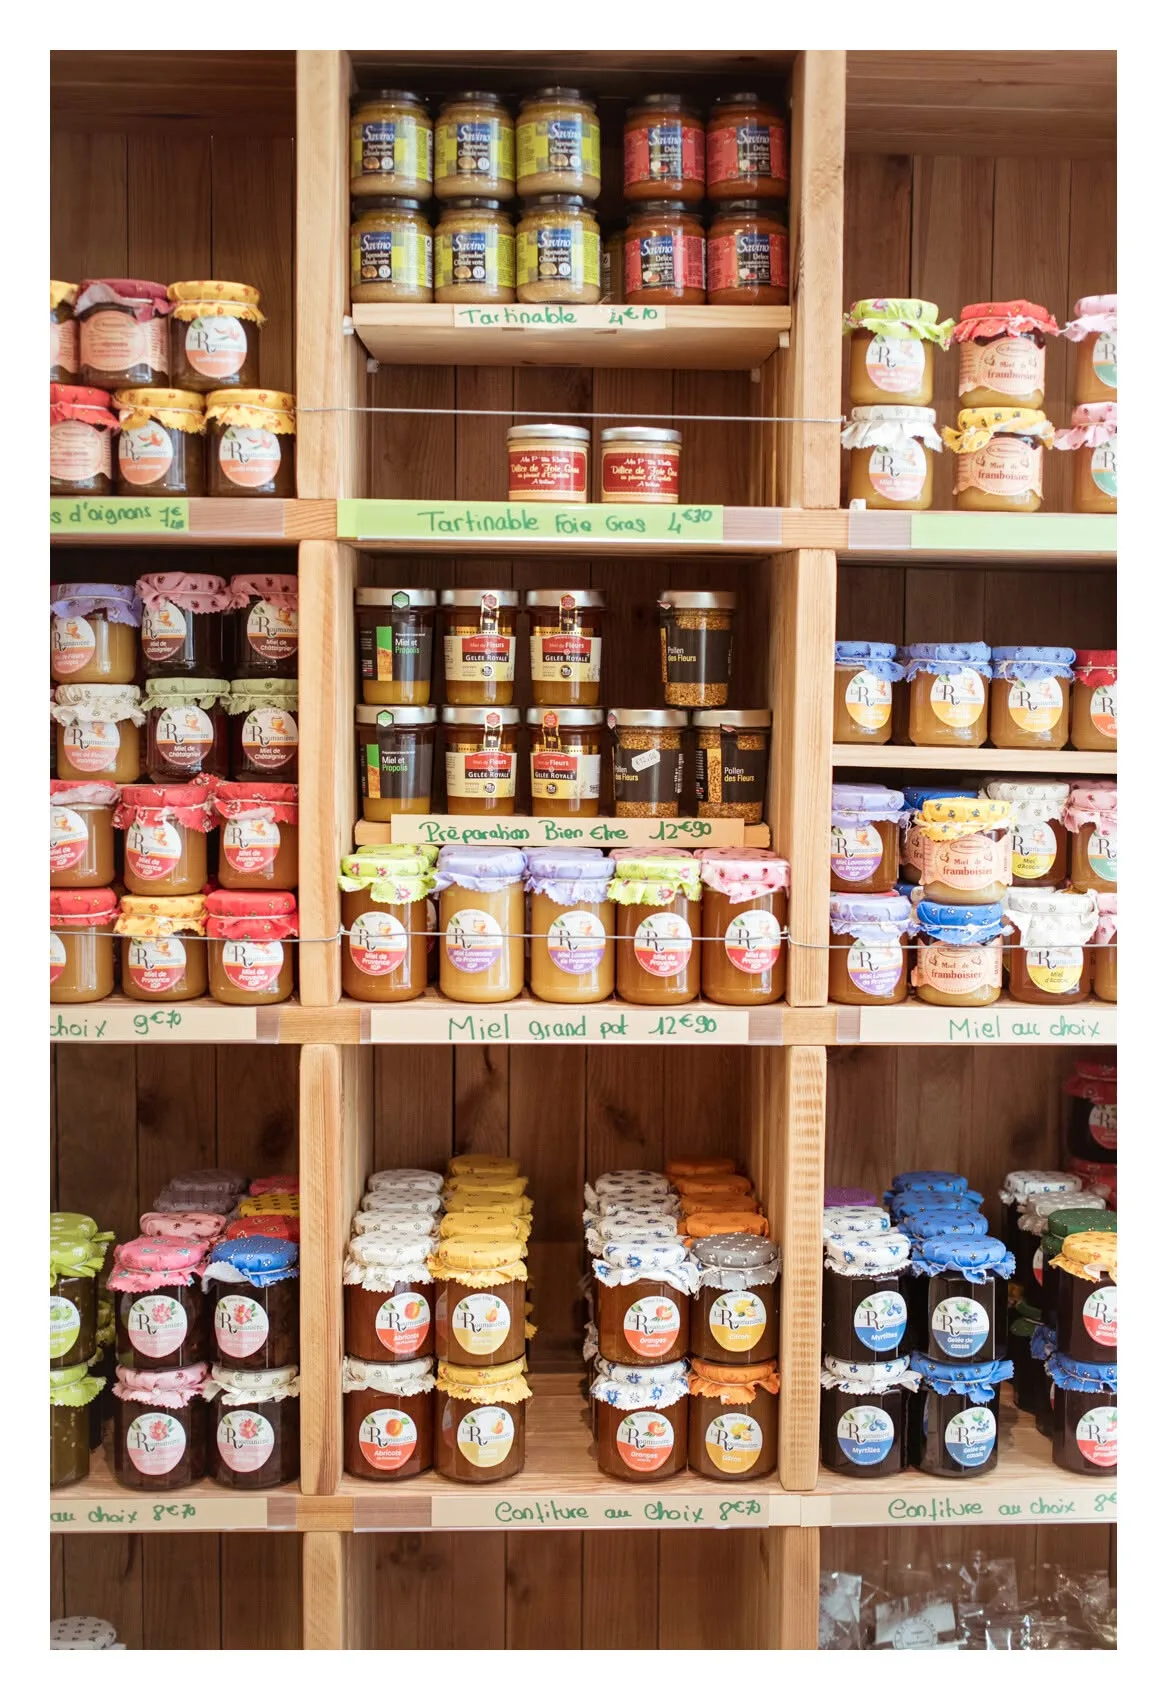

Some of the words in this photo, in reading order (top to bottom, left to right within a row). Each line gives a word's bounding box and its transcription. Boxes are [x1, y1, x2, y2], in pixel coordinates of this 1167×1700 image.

[640, 239, 673, 256] Savino
[459, 308, 577, 325] Tartinable
[417, 508, 540, 532] Tartinable
[555, 513, 592, 533] Foie
[605, 514, 646, 533] Gras
[395, 638, 410, 646] Miel
[565, 641, 584, 649] Fleurs
[487, 654, 508, 662] ROYALE
[566, 654, 588, 662] ROYALE
[677, 654, 696, 662] Fleurs
[382, 756, 397, 764] Miel
[489, 758, 507, 766] Fleurs
[549, 759, 569, 767] Fleurs
[382, 764, 408, 773] Propolis
[724, 767, 744, 775] Pollen
[489, 770, 509, 778] ROYALE
[551, 771, 574, 779] ROYALE
[622, 773, 639, 781] Fleurs
[724, 774, 736, 782] des
[737, 774, 755, 782] Fleurs
[419, 821, 529, 844] Préparation
[538, 820, 583, 840] Bien
[648, 820, 712, 842] 12€90
[953, 858, 969, 866] Miel
[931, 970, 982, 979] framboisier
[448, 1013, 509, 1040] Miel
[528, 1014, 586, 1041] grand
[600, 1014, 629, 1039] pot
[648, 1014, 717, 1036] 12€90
[949, 1015, 1001, 1041] Miel
[1011, 1018, 1041, 1036] au
[1050, 1015, 1101, 1037] choix
[495, 1501, 589, 1524] Confiture
[604, 1507, 632, 1519] au
[888, 1498, 984, 1521] Confiture
[999, 1503, 1023, 1516] au
[1030, 1497, 1076, 1515] choix
[88, 1506, 138, 1524] choix
